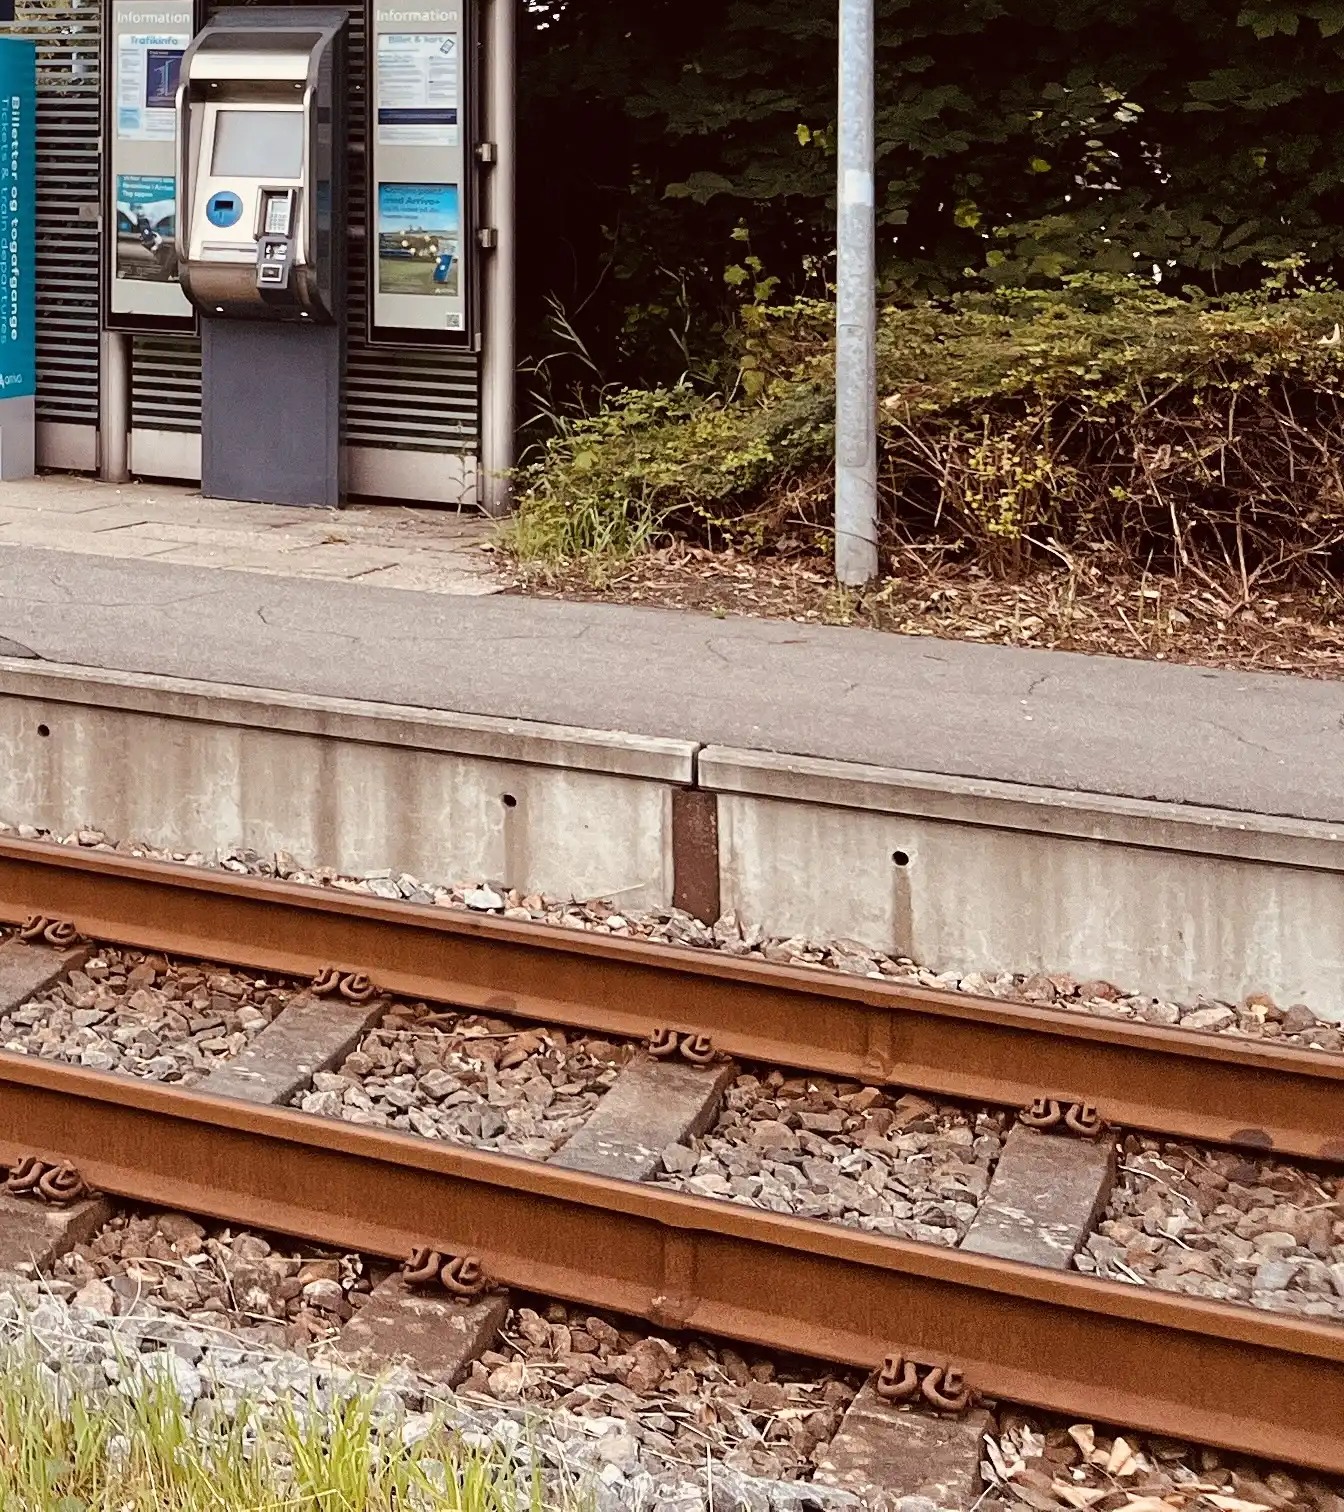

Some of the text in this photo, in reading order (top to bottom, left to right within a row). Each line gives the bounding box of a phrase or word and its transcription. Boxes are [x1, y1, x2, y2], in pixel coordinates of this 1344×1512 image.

[117, 11, 190, 24] Information
[376, 9, 458, 22] Information
[131, 36, 179, 46] Trafikinfo
[0, 96, 10, 344] Tickets & train departures
[9, 96, 20, 341] Billetter og togafgange
[4, 373, 23, 385] arriva
